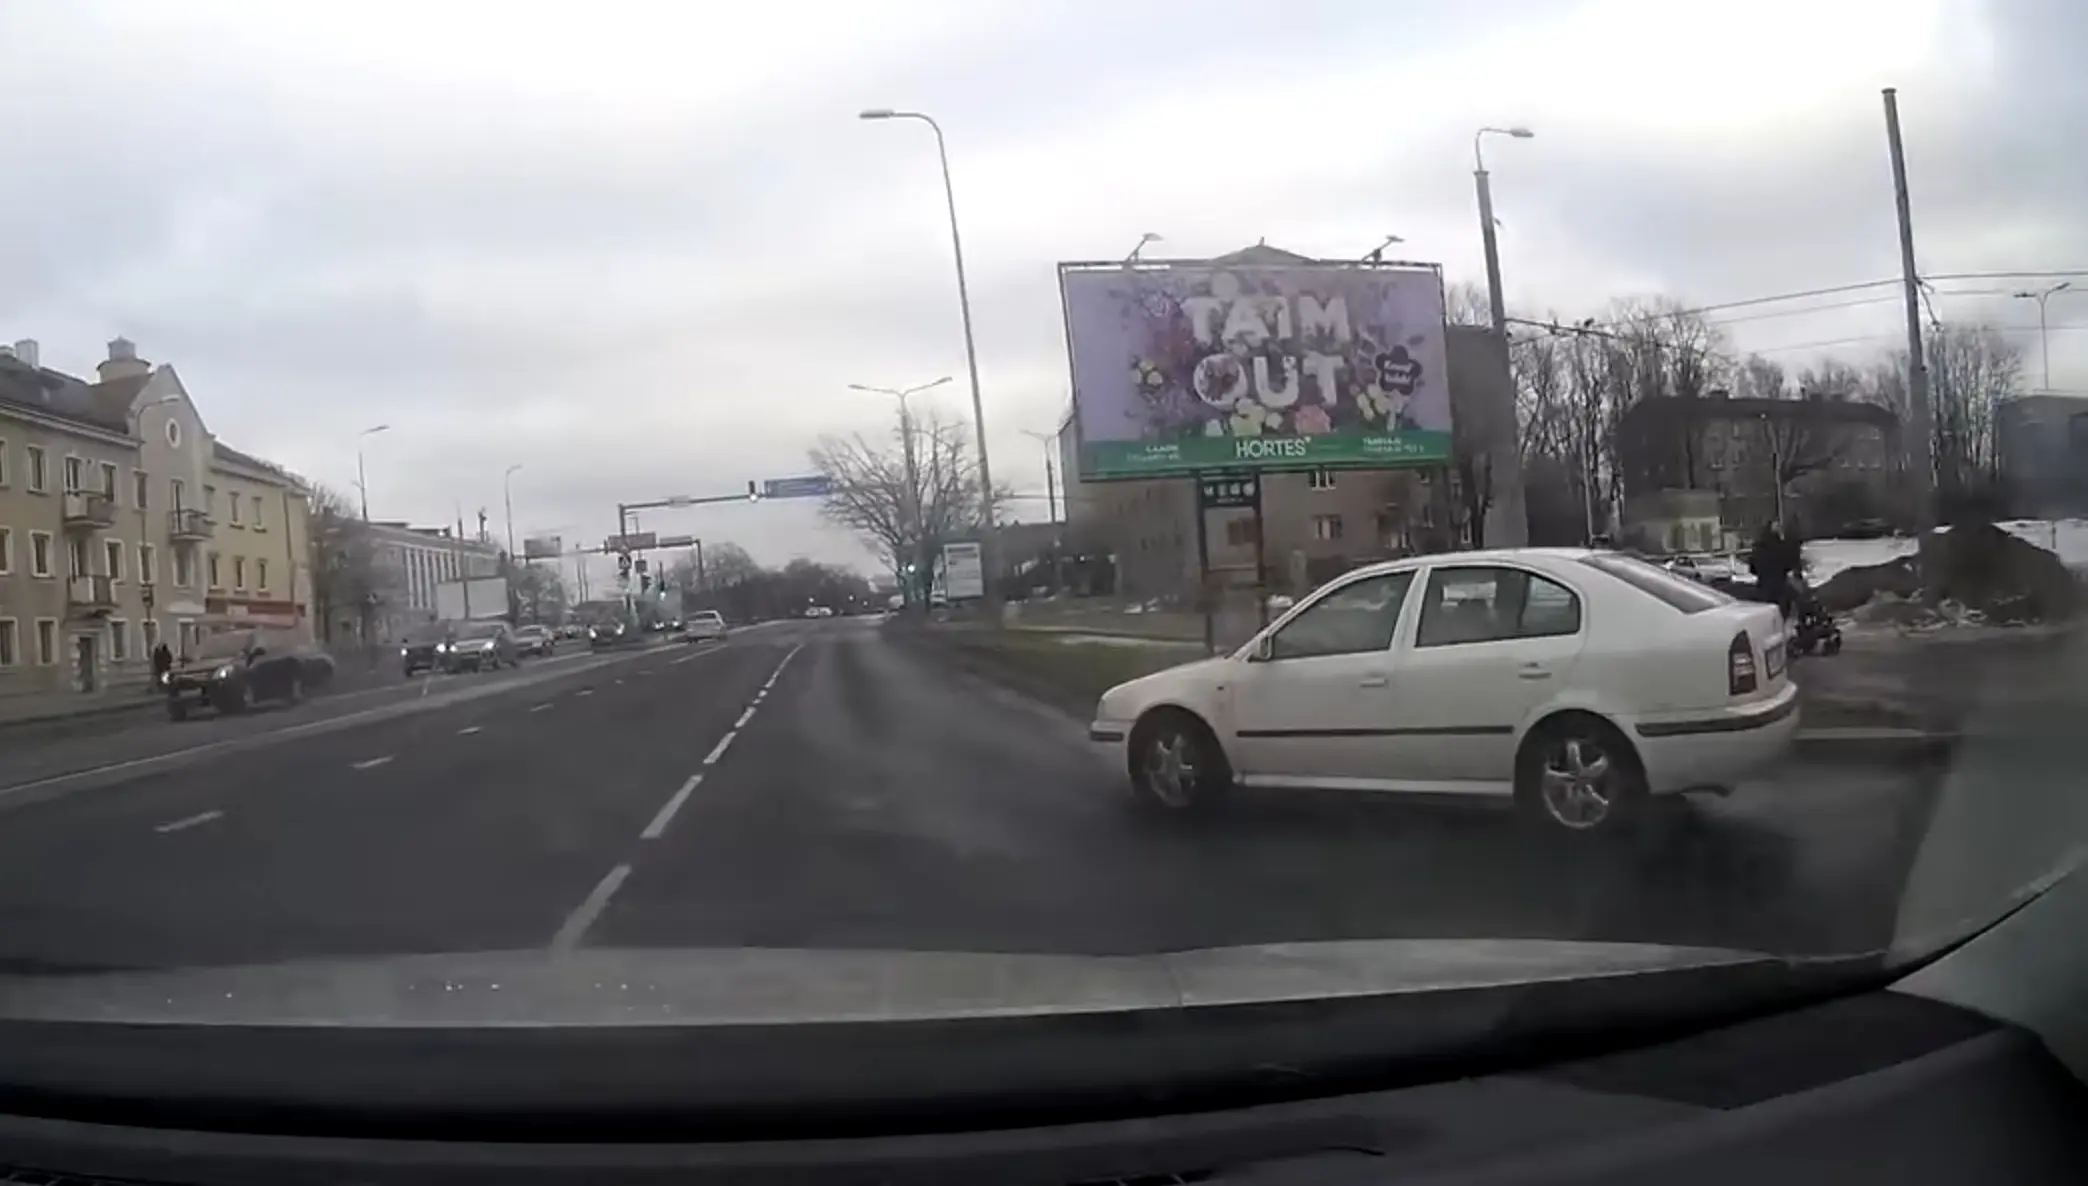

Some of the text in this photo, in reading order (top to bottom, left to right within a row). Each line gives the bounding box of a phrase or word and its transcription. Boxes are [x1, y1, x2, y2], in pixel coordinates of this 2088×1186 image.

[1180, 296, 1351, 346] TAIM
[1193, 353, 1345, 412] OUT
[1235, 438, 1307, 459] HORTES
